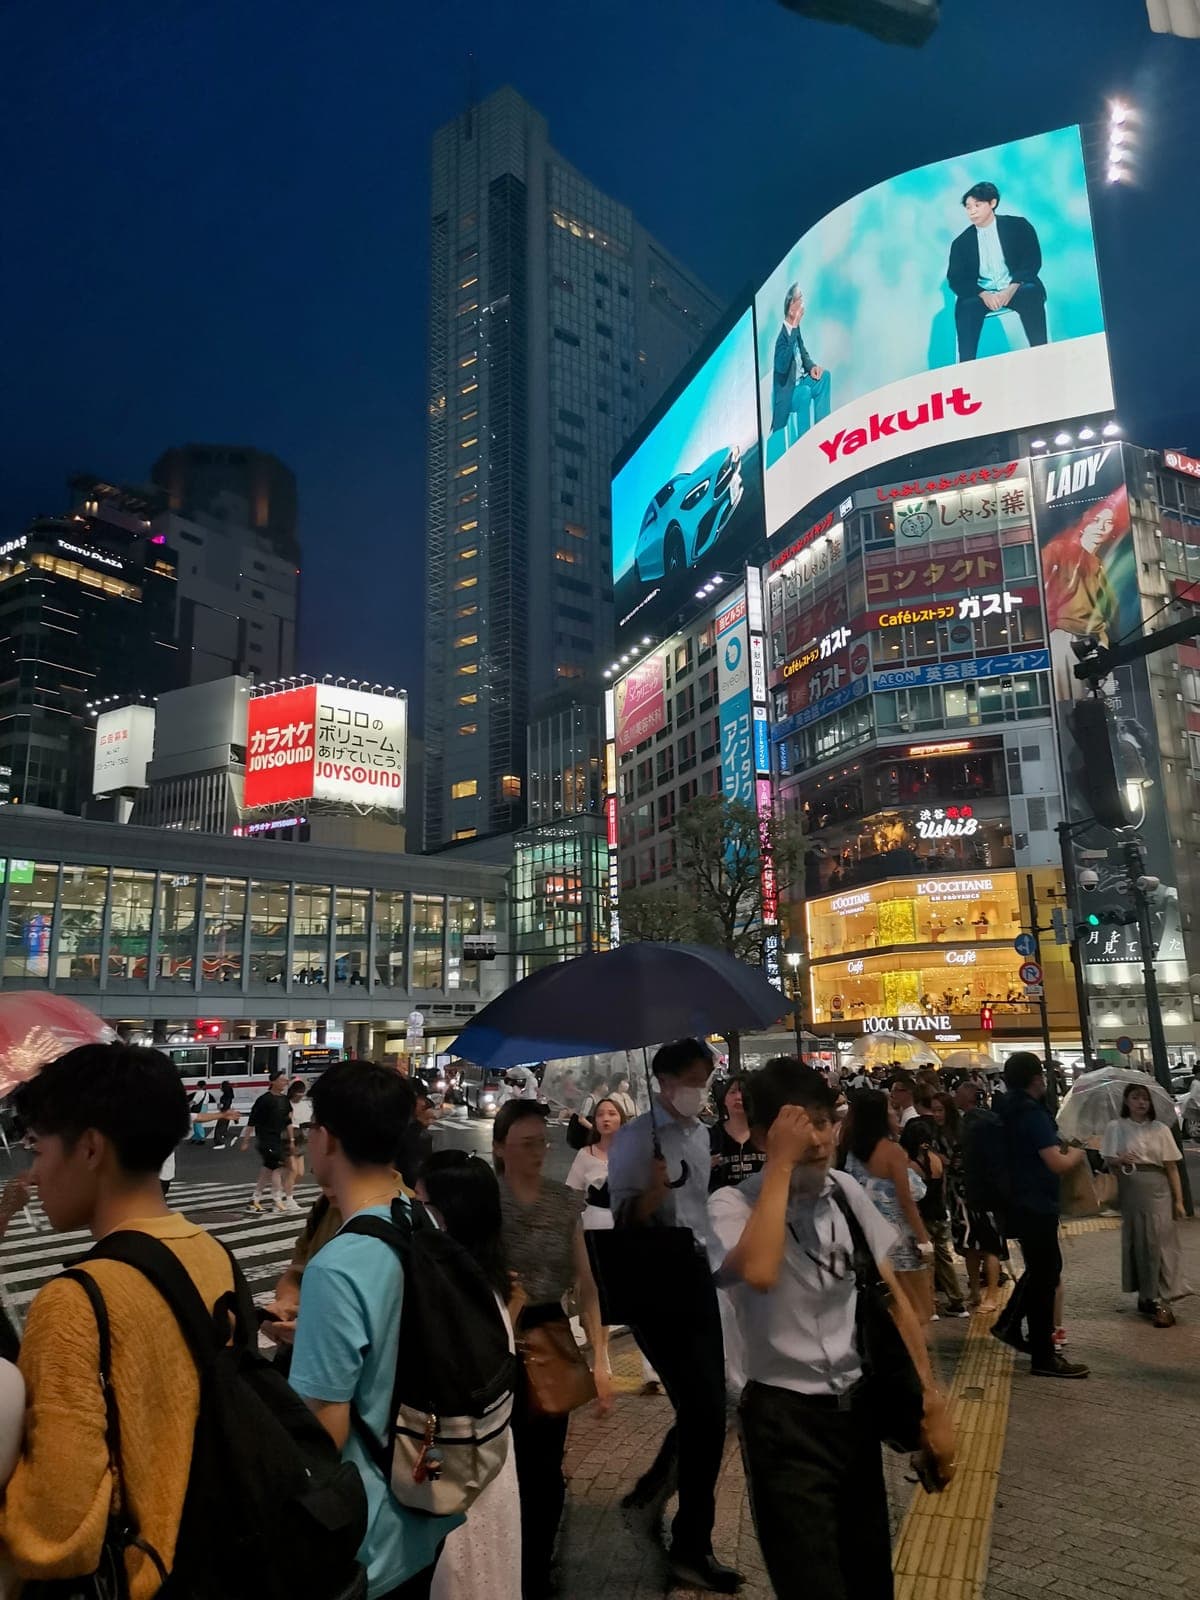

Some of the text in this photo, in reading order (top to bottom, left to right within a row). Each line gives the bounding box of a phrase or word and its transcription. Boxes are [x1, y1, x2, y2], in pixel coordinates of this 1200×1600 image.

[818, 387, 983, 464] Yakult
[876, 462, 1018, 501] しゃぶしゃぶバイキング
[1046, 449, 1112, 503] LADY
[940, 489, 1026, 527] しゃぶ葉
[57, 539, 124, 569] TOKYU PLAZA
[867, 555, 998, 595] コンタクト
[958, 591, 1024, 620] ガスト
[819, 625, 852, 660] ガスト
[808, 663, 849, 703] ガスト
[877, 654, 1046, 685] AEON 英会話イーオン
[319, 704, 384, 731] ココロの
[250, 720, 313, 755] カラオケ
[248, 745, 313, 773] JOYSOUND
[315, 761, 401, 789] JOYSOUND
[915, 817, 978, 839] Ushi8
[917, 879, 993, 895] L'OCCITANE
[848, 960, 864, 974] Café
[945, 950, 977, 966] Café
